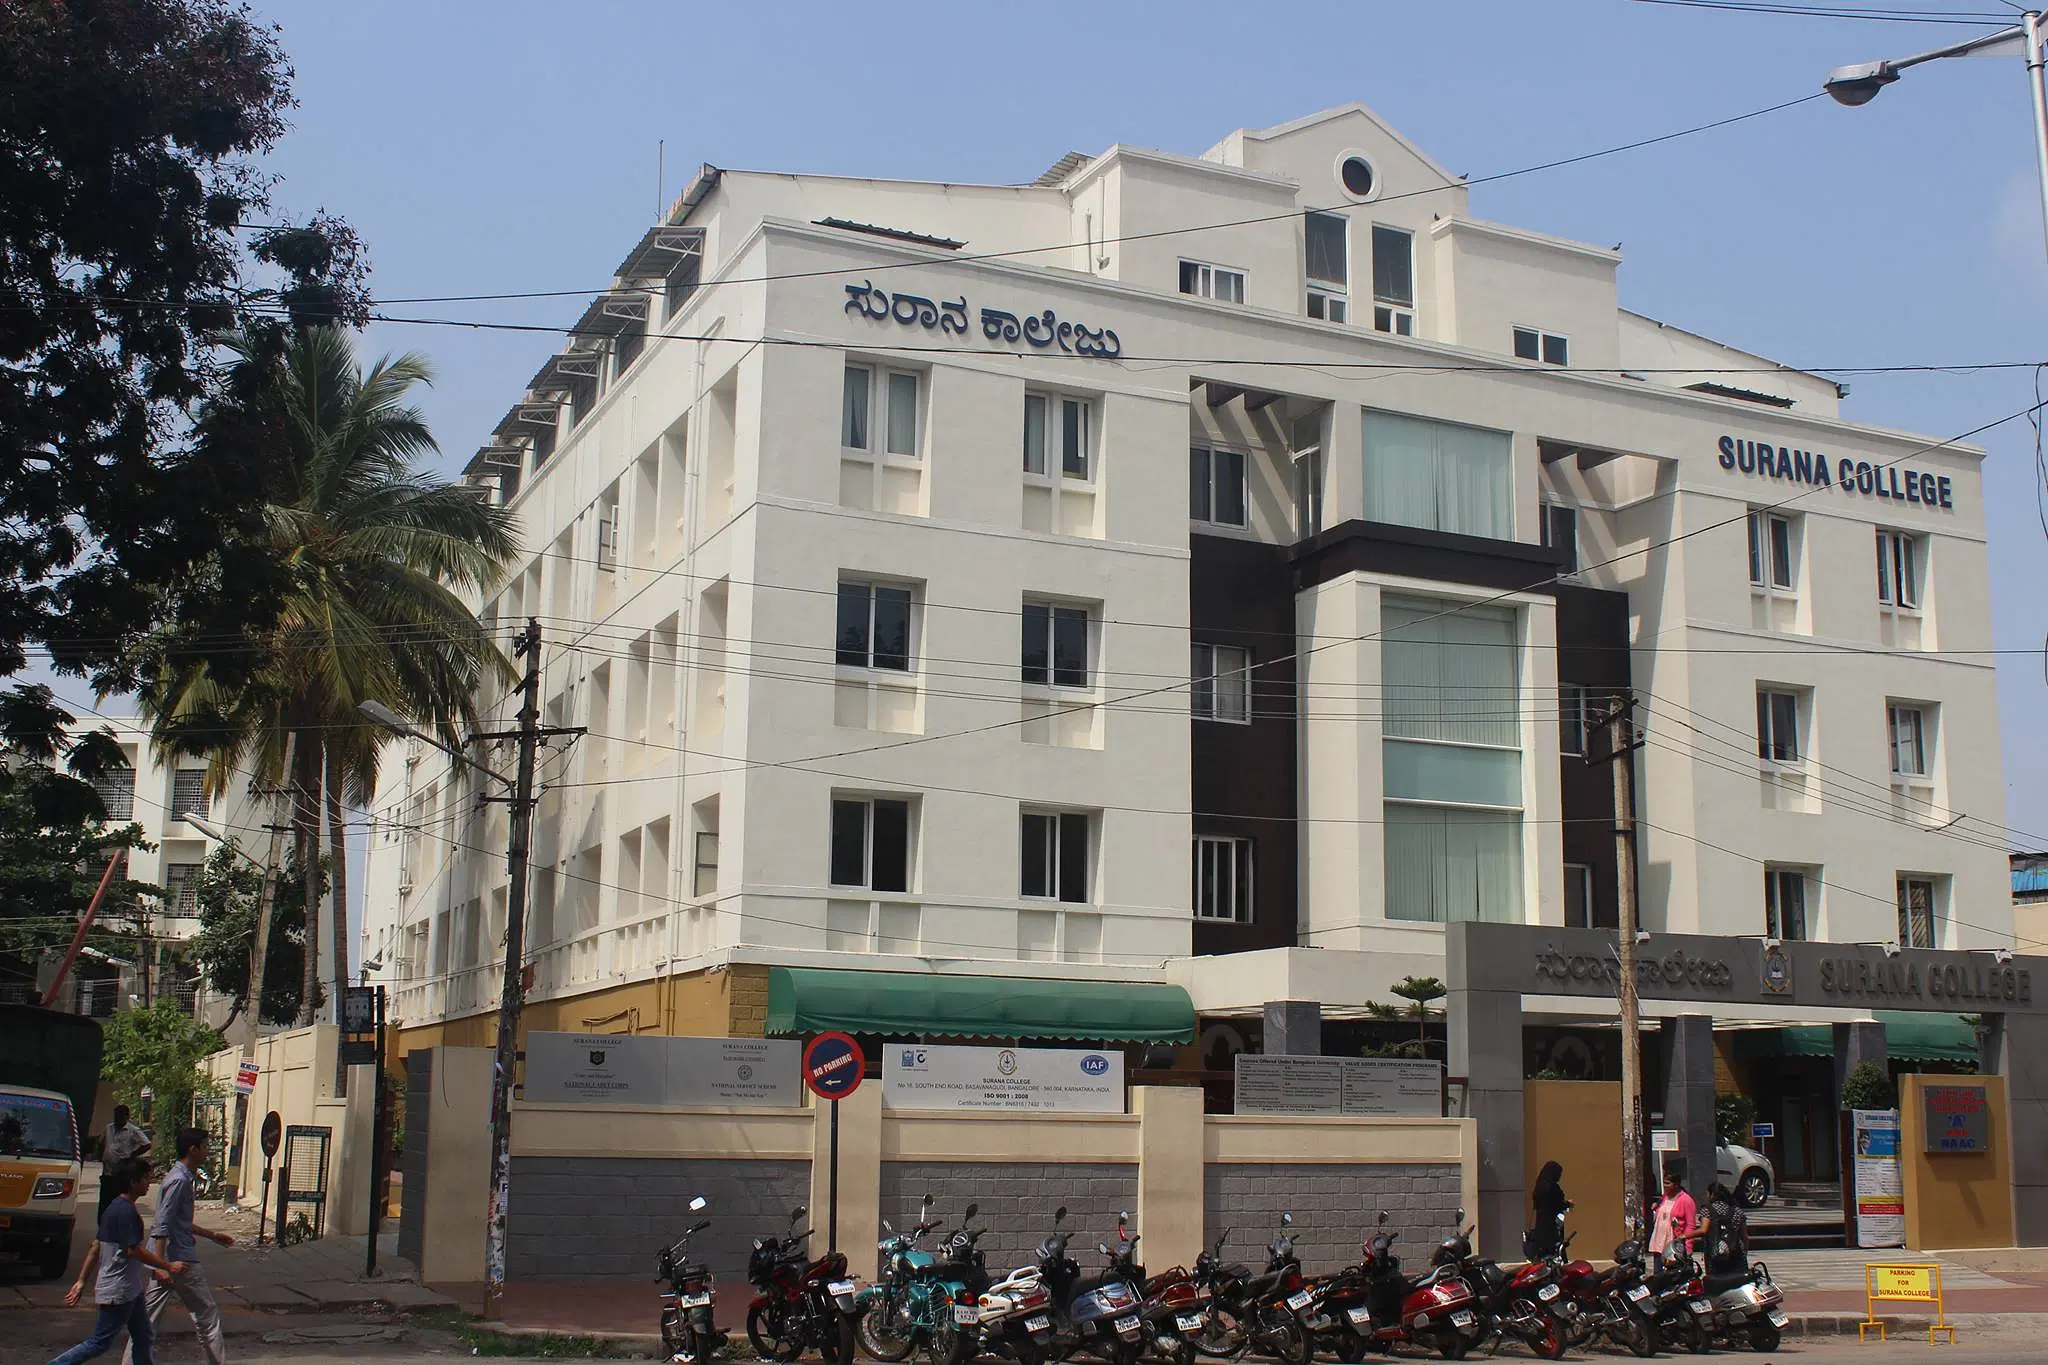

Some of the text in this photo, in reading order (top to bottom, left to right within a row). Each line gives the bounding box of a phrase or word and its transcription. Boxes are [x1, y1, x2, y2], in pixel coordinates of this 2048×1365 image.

[845, 279, 1120, 358] ಸುರಾನ ಕಾಲೇಜು
[1718, 435, 1953, 509] SURANA COLLEGE
[1820, 958, 2032, 1001] SURANA COLLEGE
[813, 1053, 853, 1077] NO PARKING
[1086, 1061, 1104, 1070] IAF
